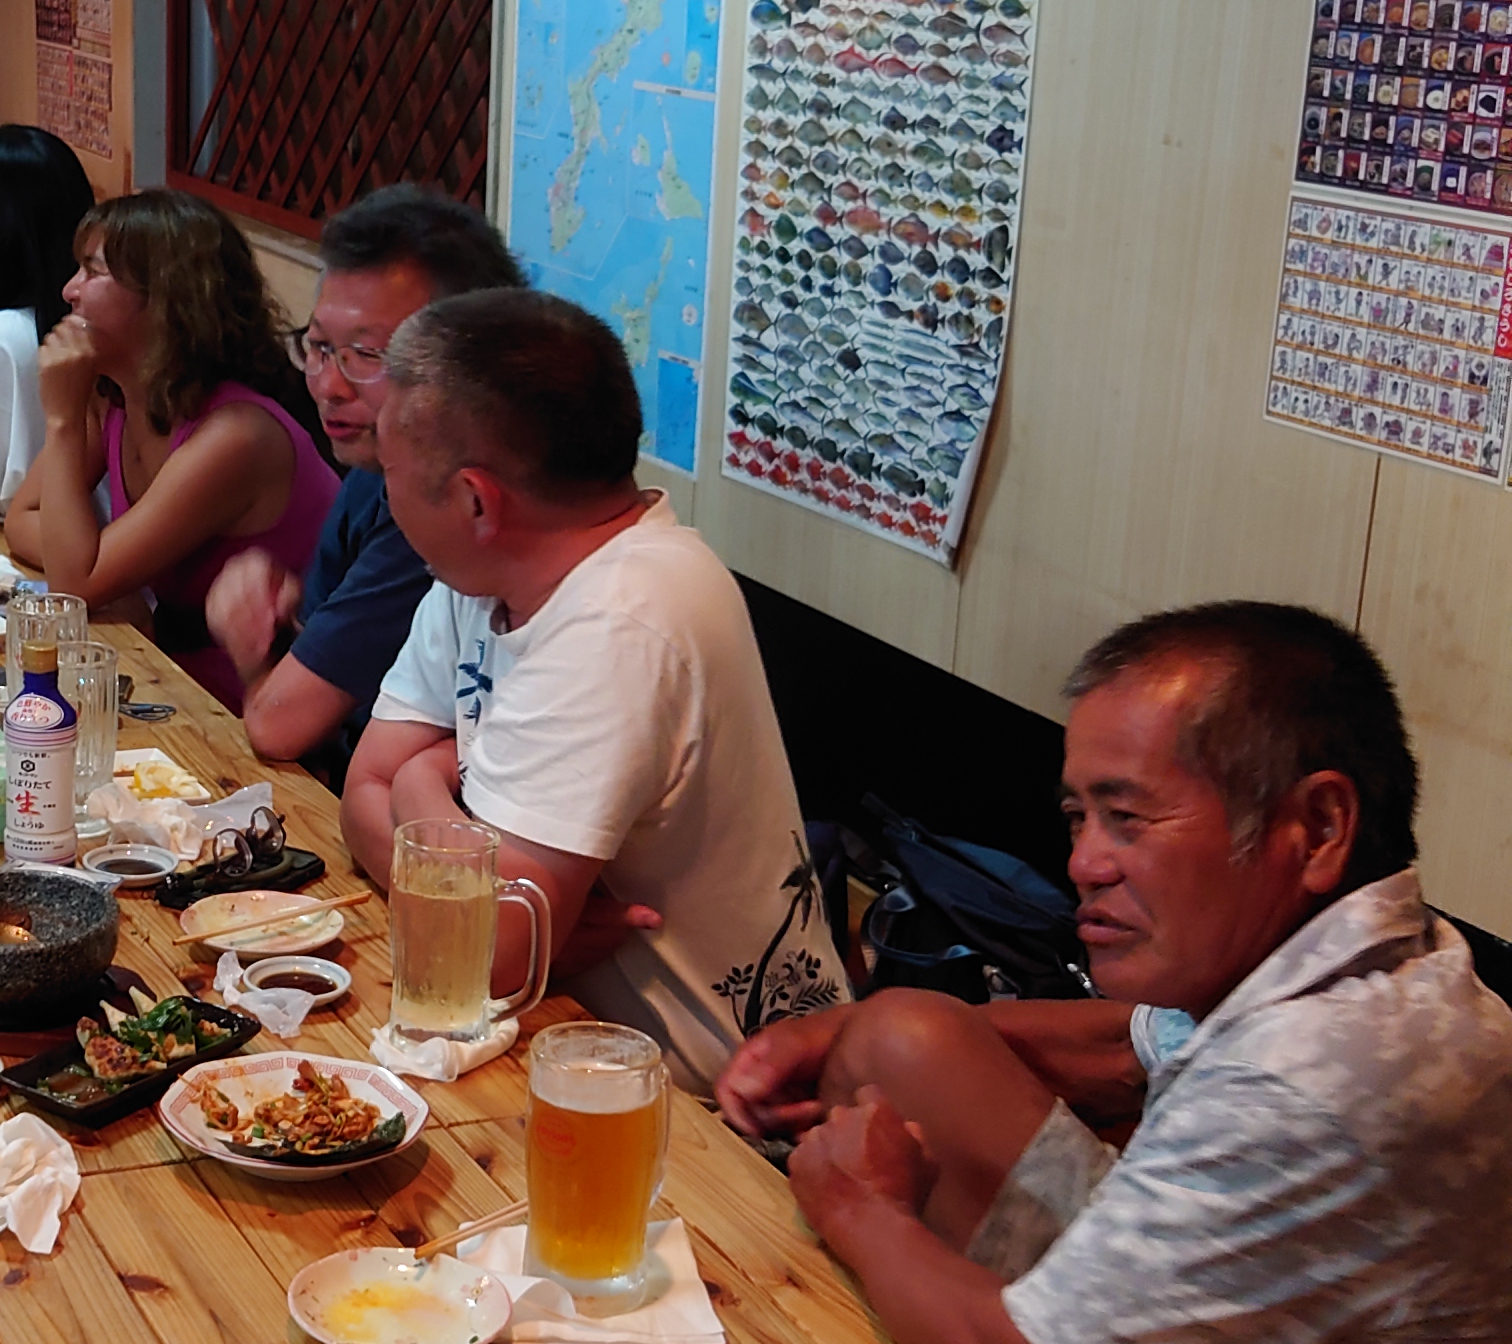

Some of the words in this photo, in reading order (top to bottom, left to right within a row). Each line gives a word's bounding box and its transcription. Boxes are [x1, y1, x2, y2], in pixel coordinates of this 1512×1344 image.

[8, 775, 53, 790] しぼりたて
[14, 789, 42, 816] 生
[13, 818, 45, 830] しょうゆ
